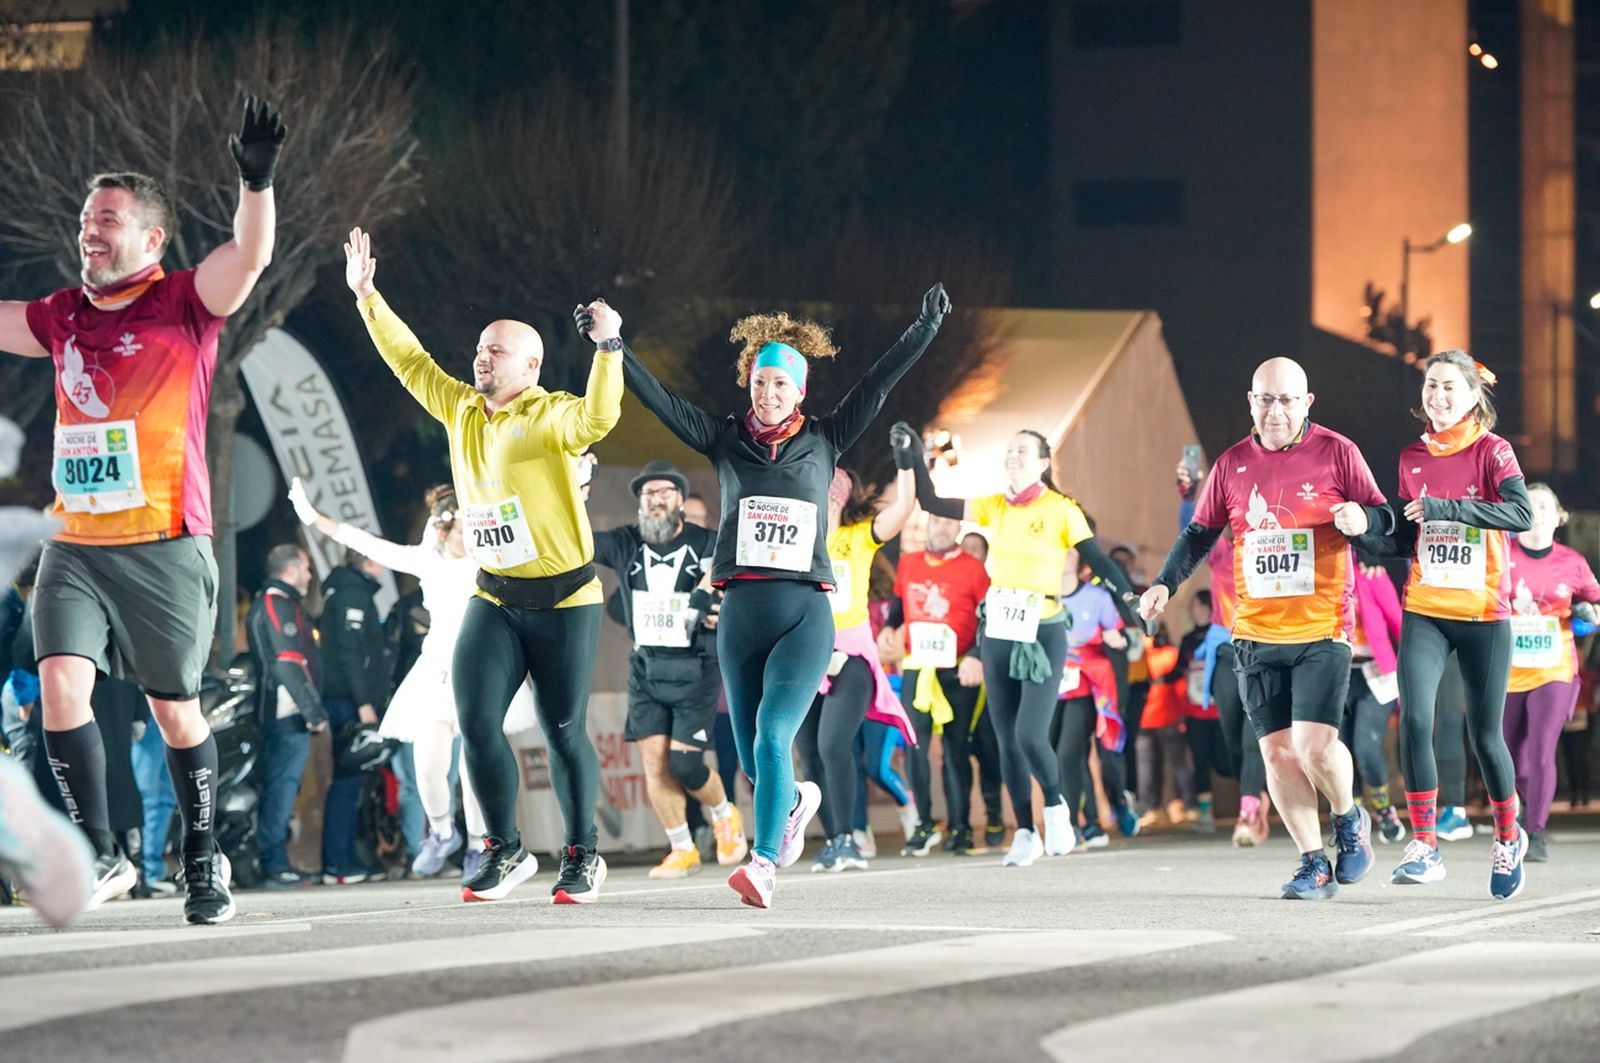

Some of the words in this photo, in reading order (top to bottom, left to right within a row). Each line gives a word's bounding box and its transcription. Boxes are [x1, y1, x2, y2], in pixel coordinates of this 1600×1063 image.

[71, 381, 92, 405] 43
[88, 434, 96, 444] DE
[73, 446, 99, 456] ANTON
[756, 504, 779, 513] NOCHE
[780, 506, 789, 514] DE
[747, 511, 762, 520] SAN
[763, 512, 789, 523] ANTON
[473, 524, 515, 548] 2470
[754, 521, 798, 546] 3712
[1431, 527, 1449, 535] NOCHE
[1450, 527, 1459, 535] DE
[1435, 536, 1459, 544] ANTON
[1428, 544, 1472, 565] 2948
[1255, 553, 1300, 574] 5047
[644, 613, 674, 629] 2188
[1515, 635, 1552, 650] 4599
[188, 766, 213, 831] Kalenji
